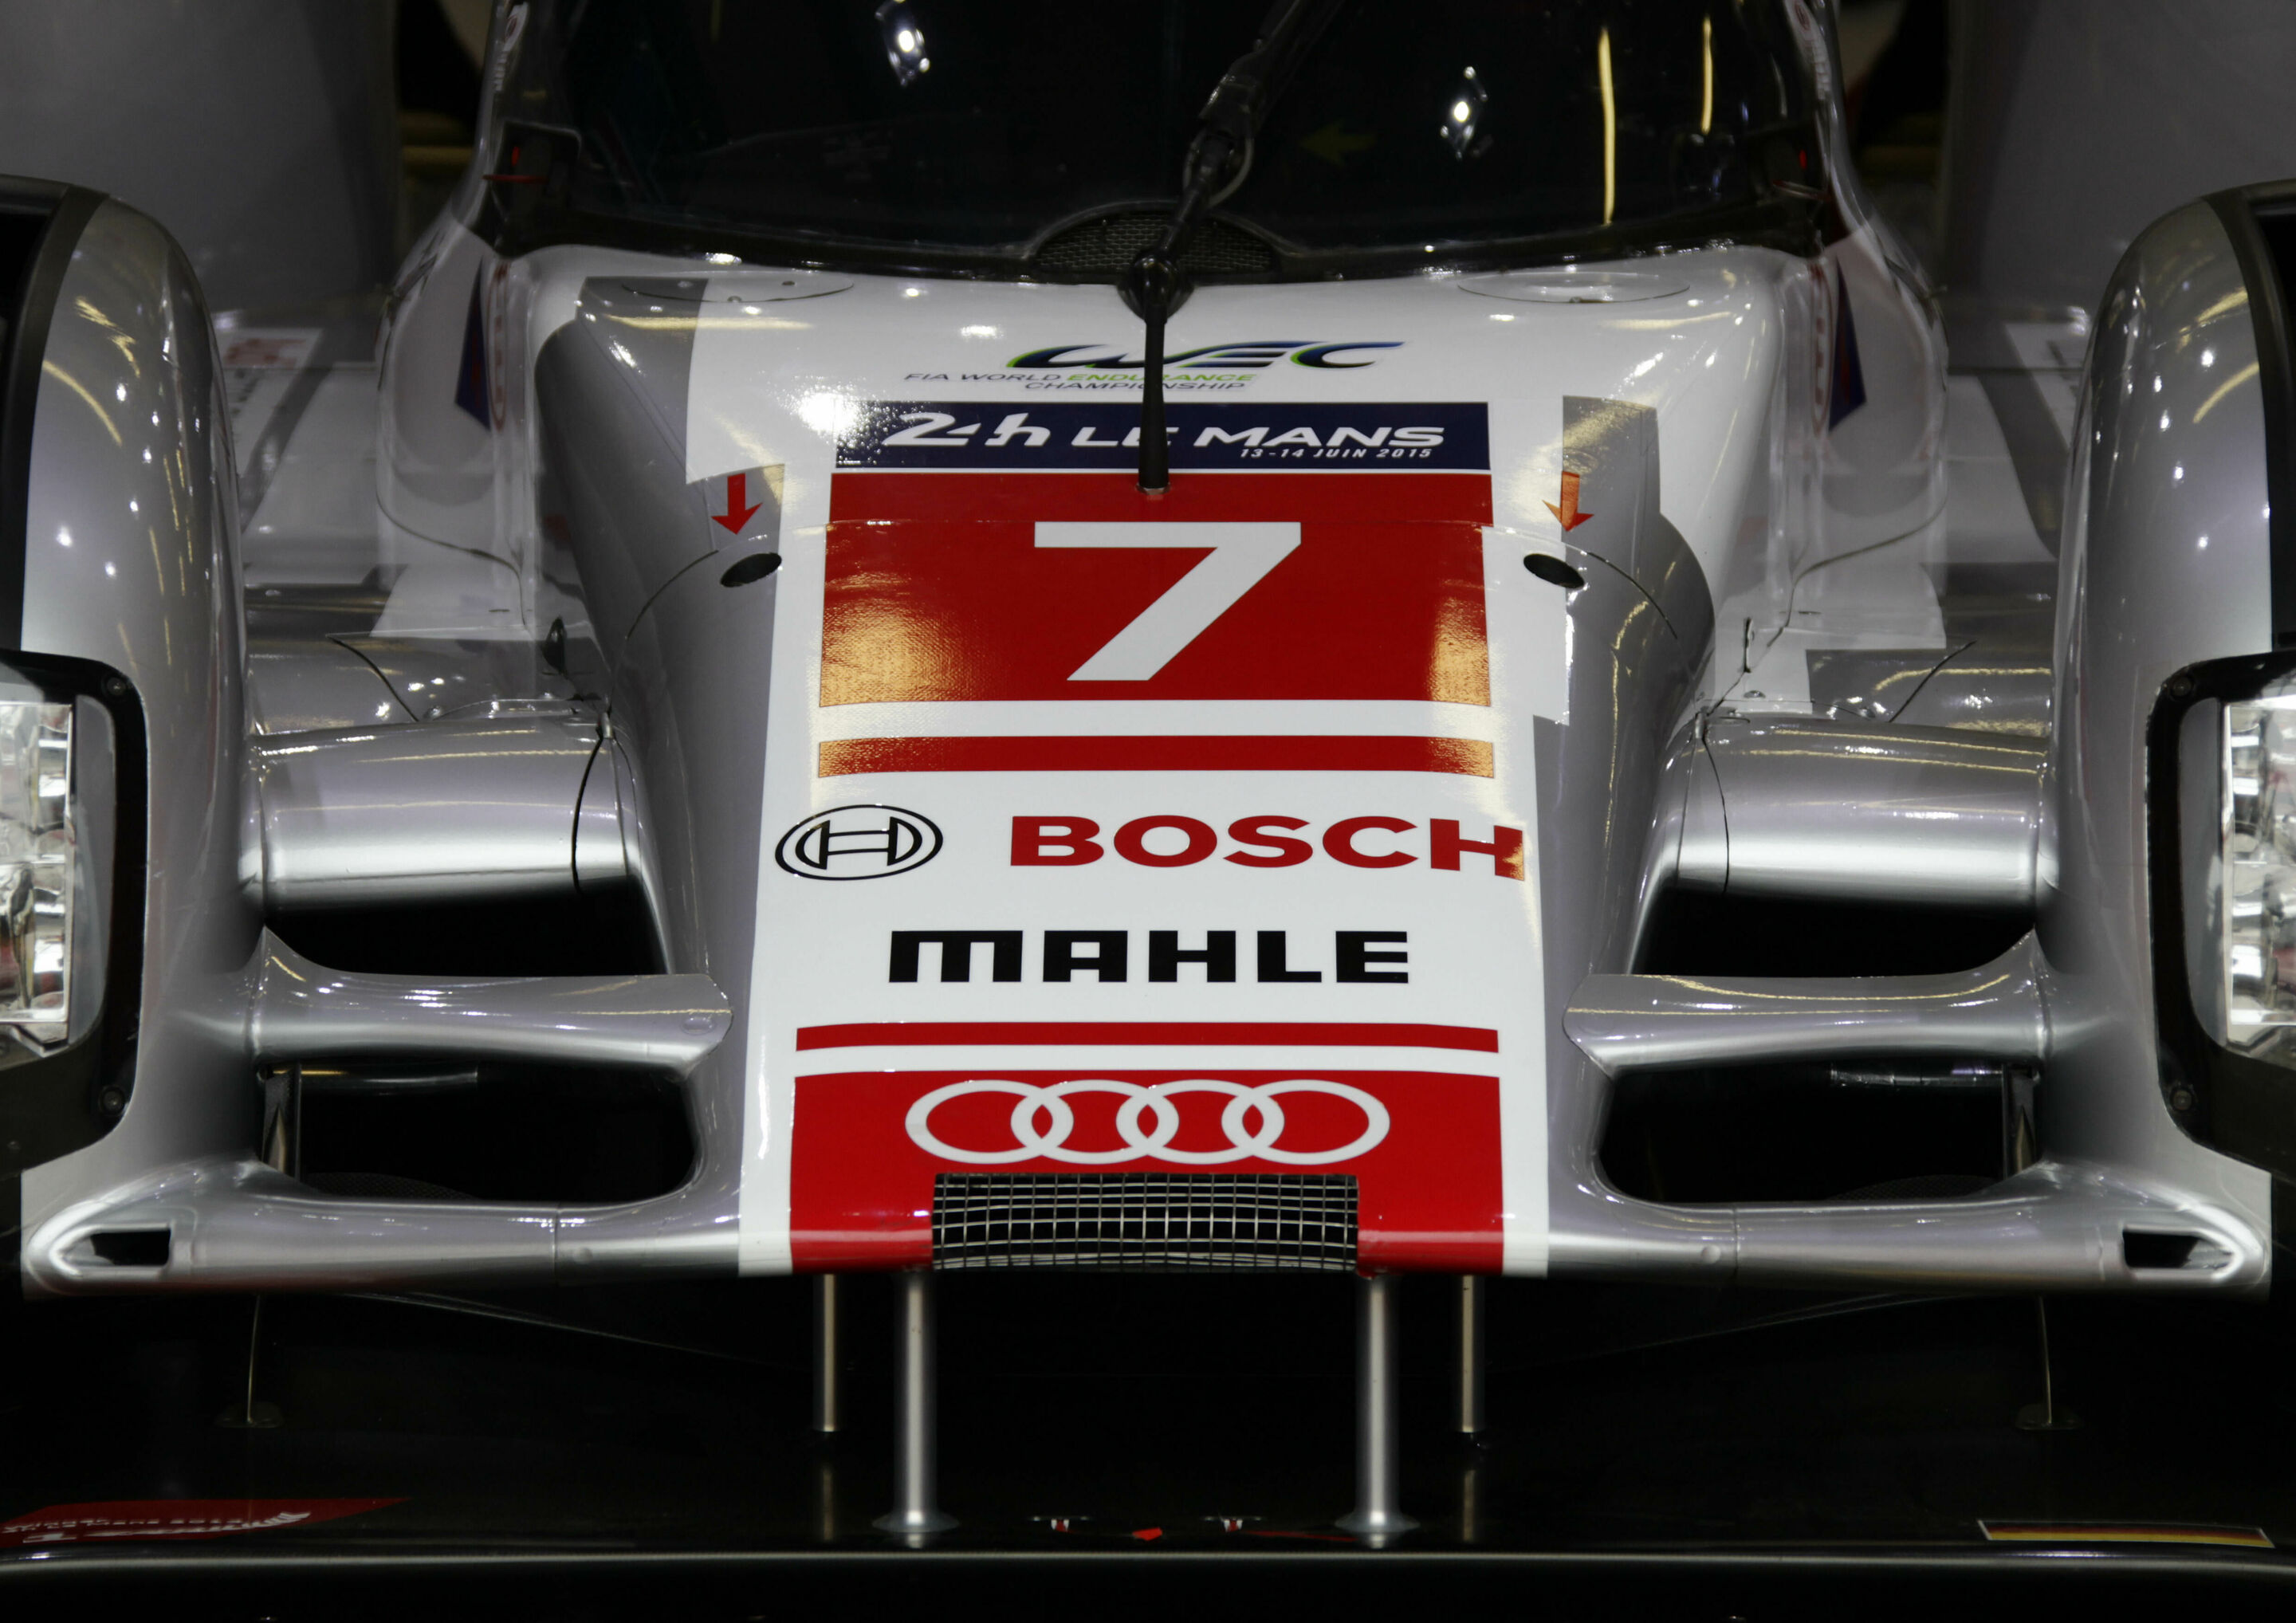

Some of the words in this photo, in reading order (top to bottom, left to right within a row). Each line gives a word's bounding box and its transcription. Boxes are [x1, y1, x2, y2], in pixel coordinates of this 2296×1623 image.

[1193, 426, 1445, 447] MANS
[1240, 448, 1305, 458] 13-14
[1312, 448, 1367, 458] JUIN
[1375, 448, 1433, 458] 2015
[1034, 521, 1301, 681] 7
[1010, 815, 1524, 882] BOSCH
[888, 929, 1408, 984] MAHLE
